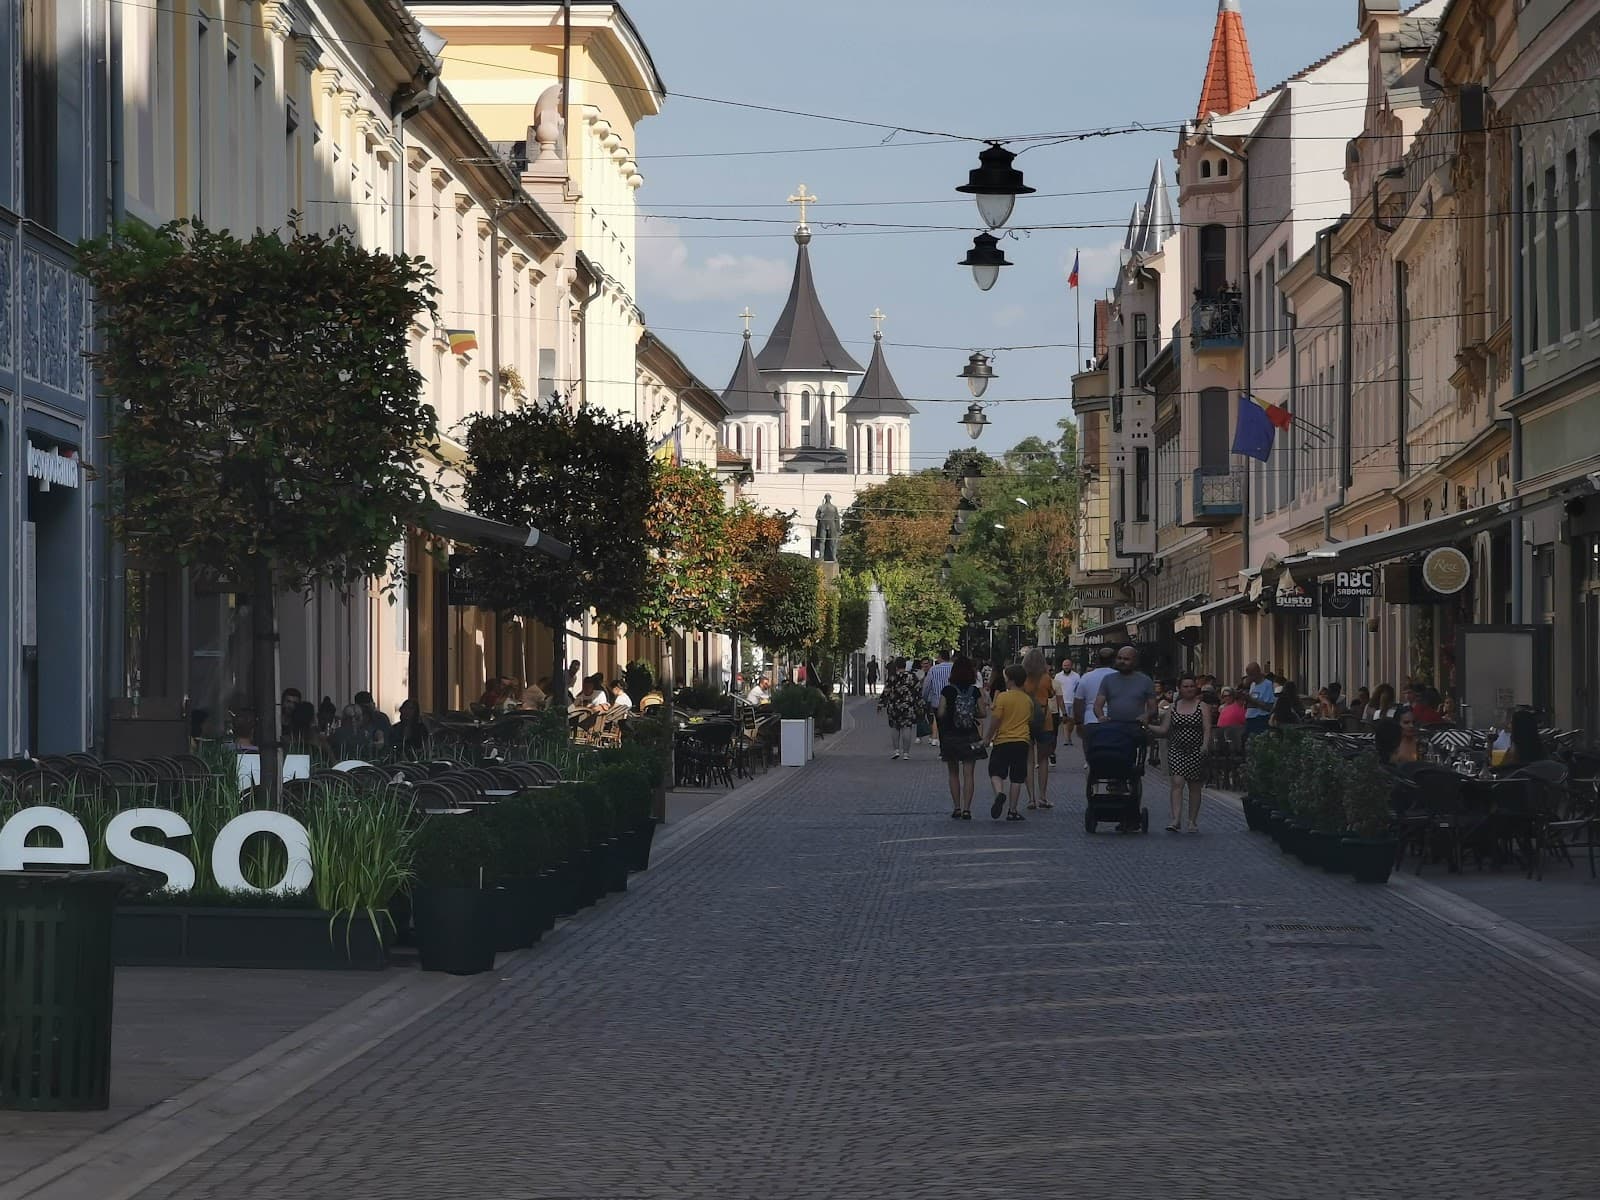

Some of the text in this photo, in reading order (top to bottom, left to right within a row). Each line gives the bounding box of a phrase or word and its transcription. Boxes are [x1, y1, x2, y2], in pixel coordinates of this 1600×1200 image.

[1337, 572, 1372, 587] ABC
[1337, 588, 1372, 596] SABOMAG
[1276, 596, 1313, 607] gusto
[0, 806, 314, 896] eso
